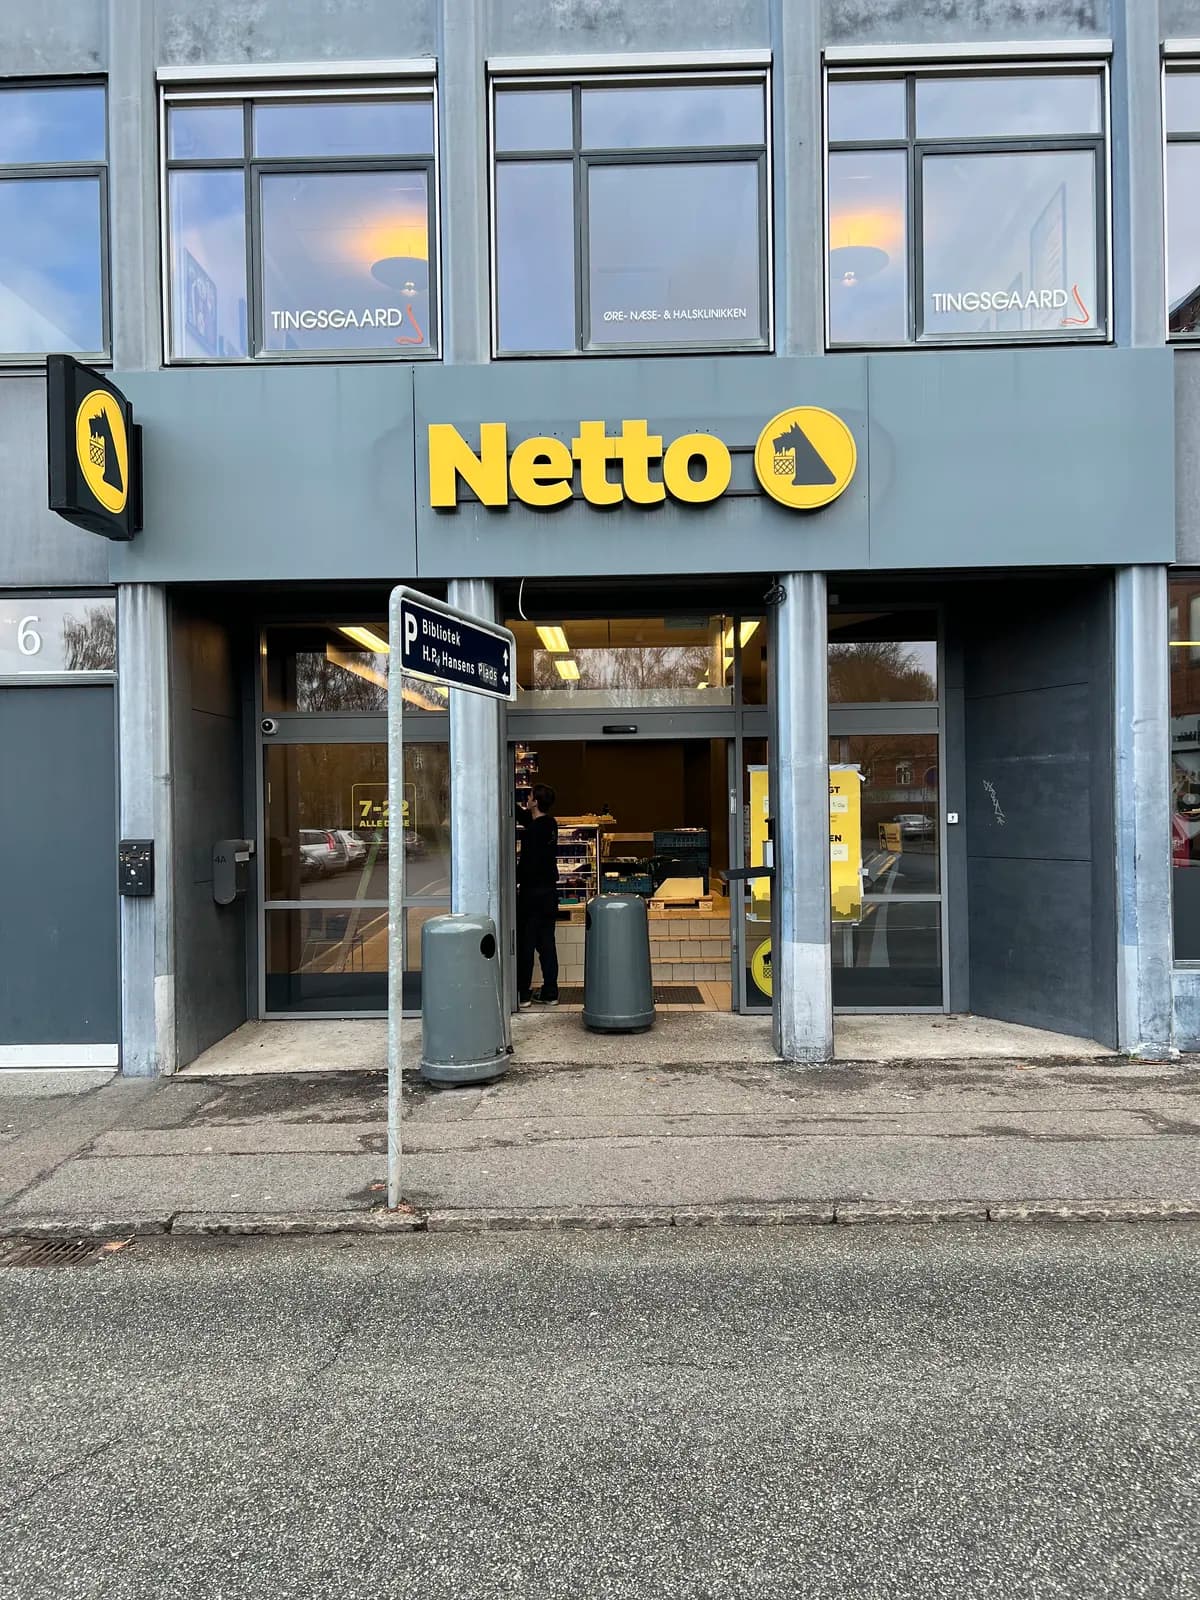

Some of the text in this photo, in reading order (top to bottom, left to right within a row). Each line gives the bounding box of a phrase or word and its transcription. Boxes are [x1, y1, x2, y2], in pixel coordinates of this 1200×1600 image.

[933, 289, 1068, 312] TINGSGAARD
[271, 308, 402, 329] TINGSGAARD
[603, 308, 747, 321] ØRE- NÆSE- & HALSKLINIKKEN
[428, 419, 732, 507] Netto
[18, 615, 41, 656] 6
[405, 611, 418, 656] P
[422, 618, 461, 647] Bibliotek
[442, 651, 475, 675] Hansens
[214, 855, 227, 865] 4A
